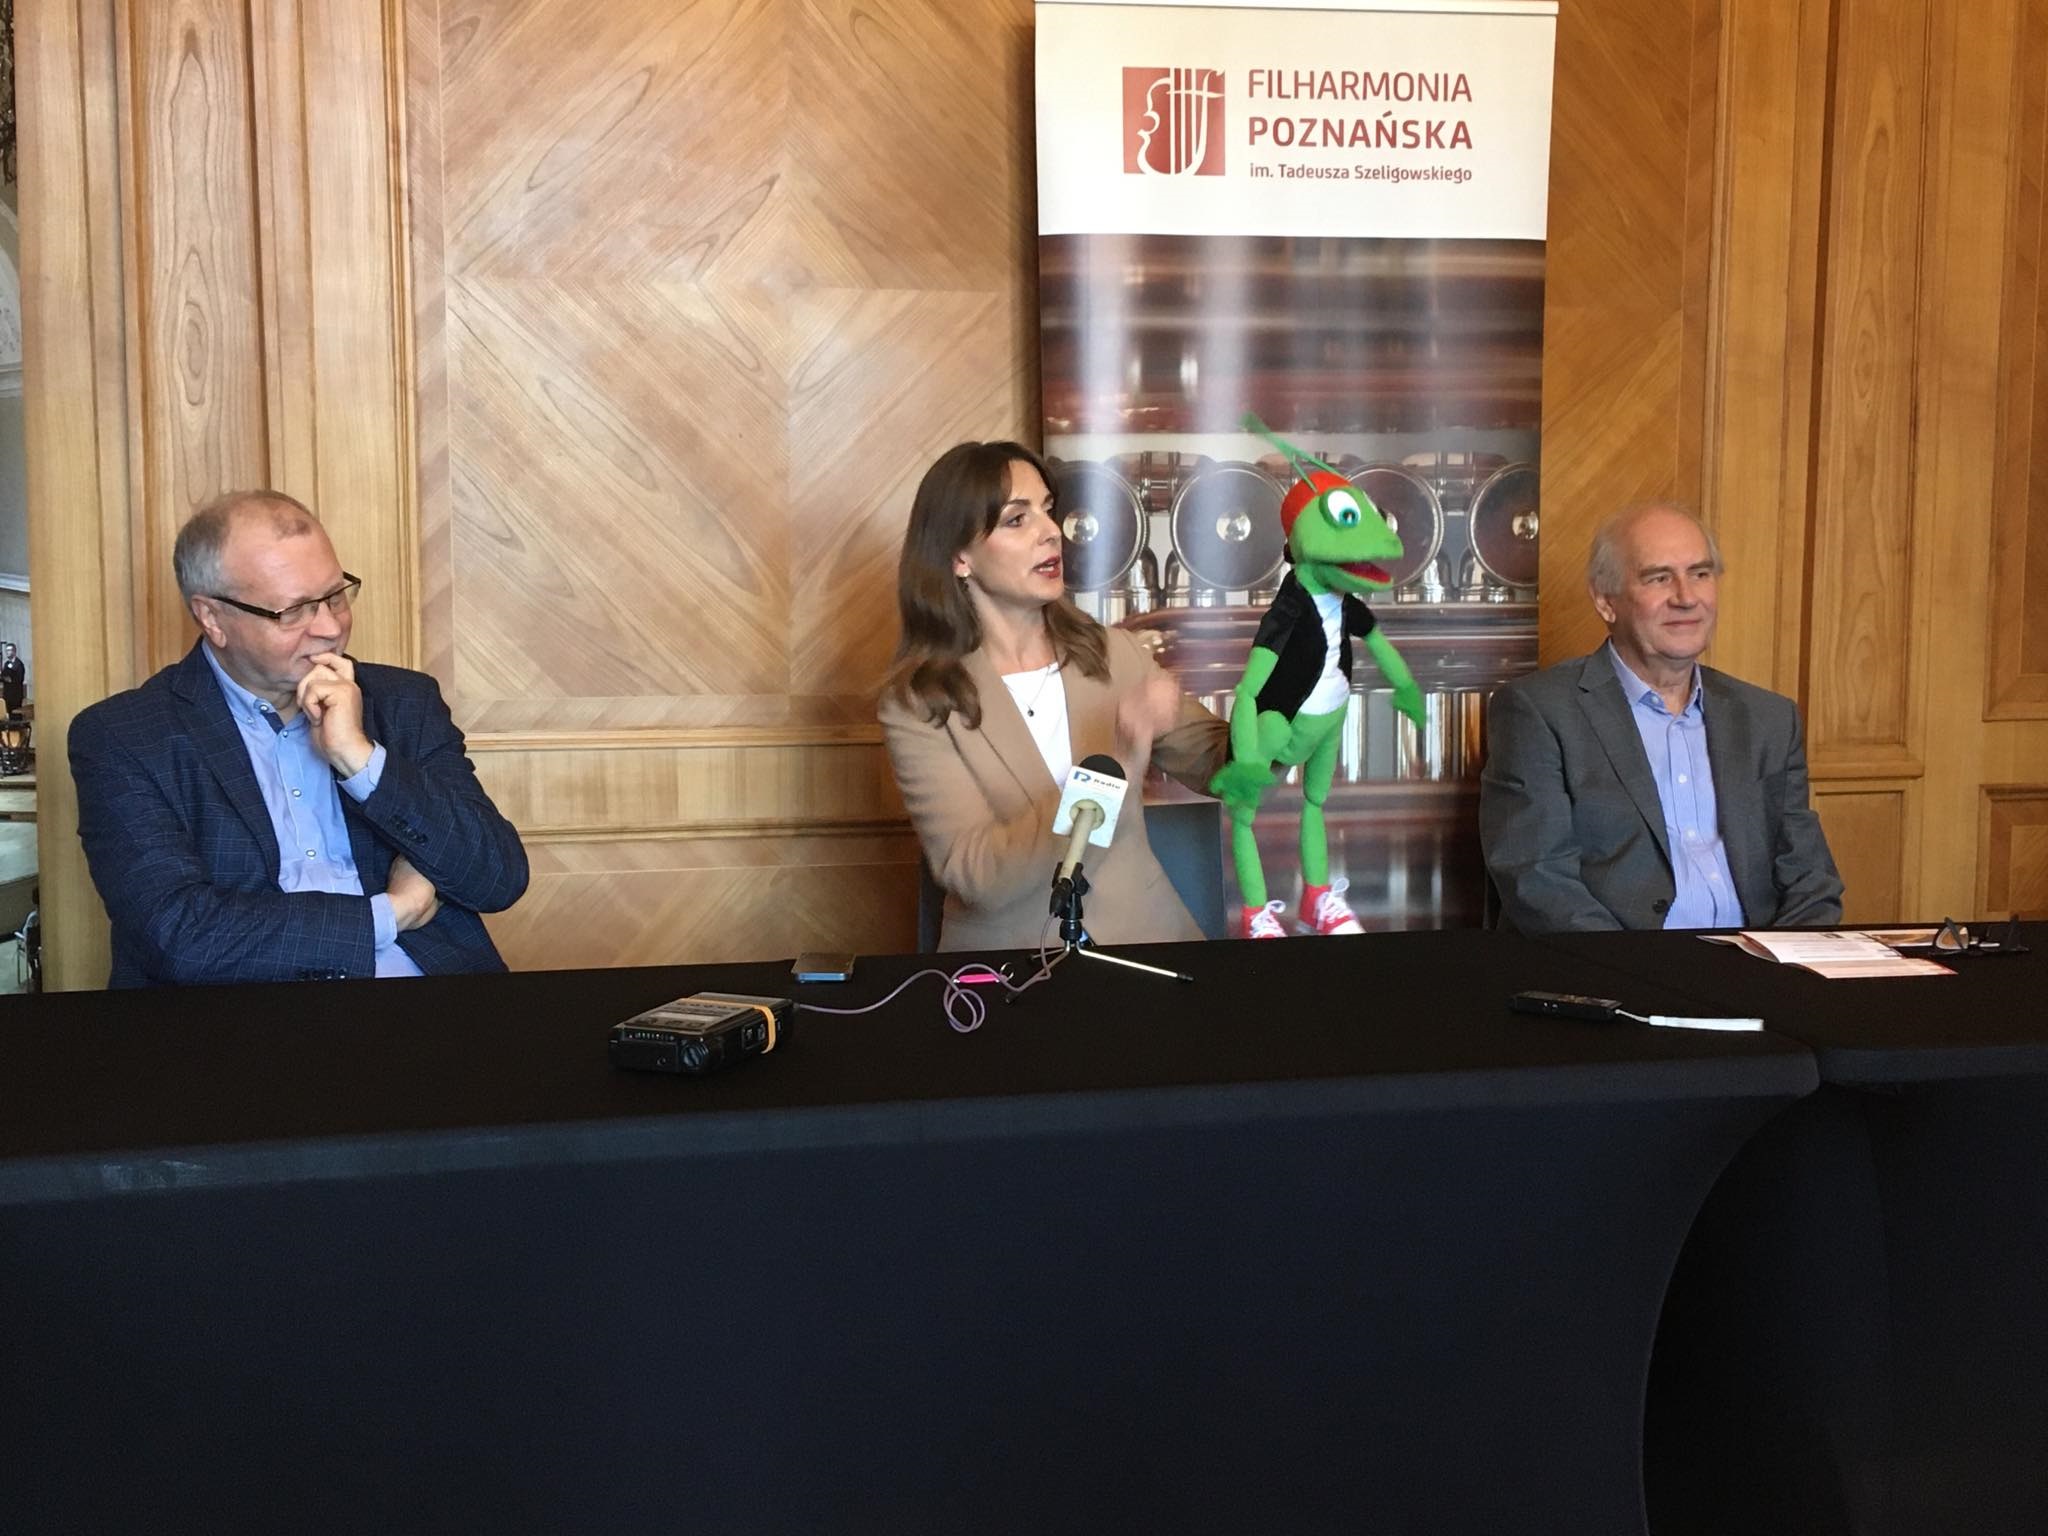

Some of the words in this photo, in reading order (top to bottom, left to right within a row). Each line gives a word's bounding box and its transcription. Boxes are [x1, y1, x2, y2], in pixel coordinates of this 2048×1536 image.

[1248, 69, 1473, 102] FILHARMONIA
[1248, 110, 1473, 149] POZNAŃSKA
[1250, 163, 1274, 178] im.
[1278, 163, 1350, 179] Tadeusza
[1354, 164, 1473, 183] Szeligowskiego
